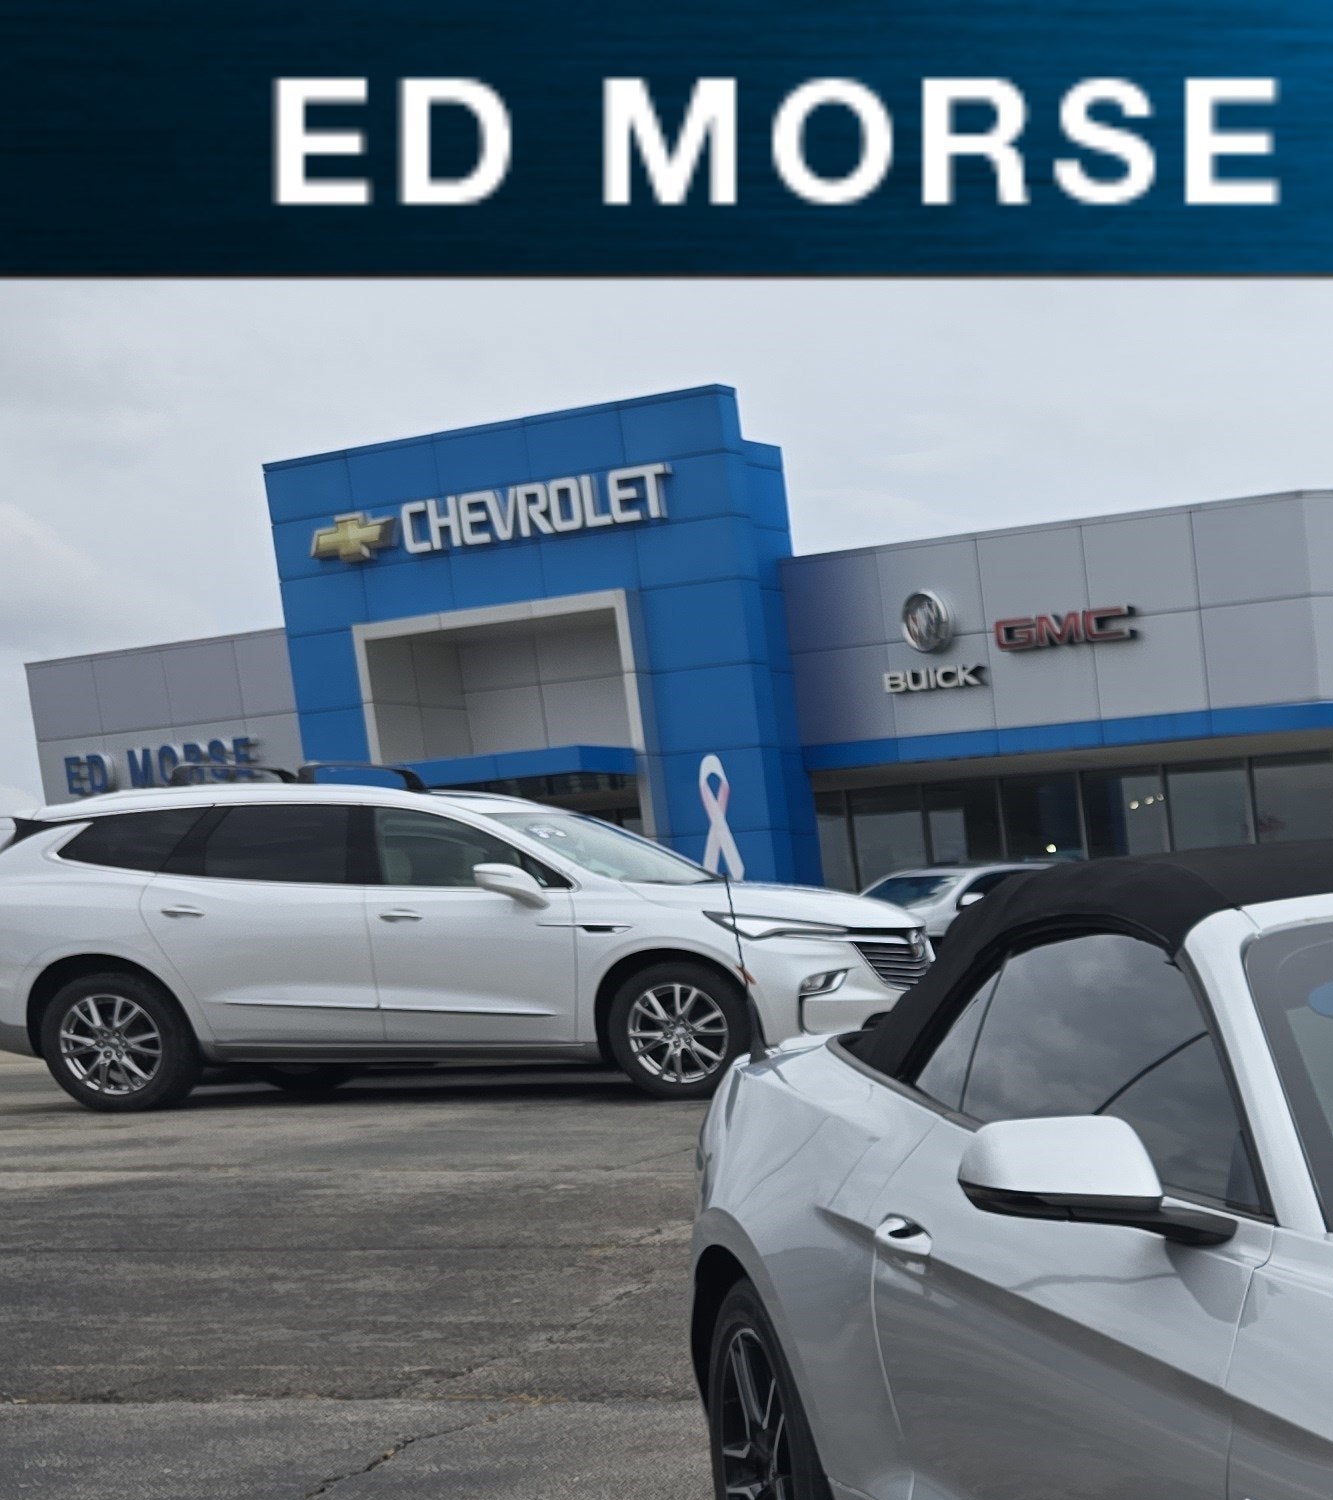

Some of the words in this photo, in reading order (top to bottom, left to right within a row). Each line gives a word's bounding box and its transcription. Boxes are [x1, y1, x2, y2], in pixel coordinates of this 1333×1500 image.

[400, 462, 673, 554] CHEVROLET
[993, 605, 1136, 651] GMC
[884, 663, 986, 693] BUICK
[64, 753, 112, 795] ED
